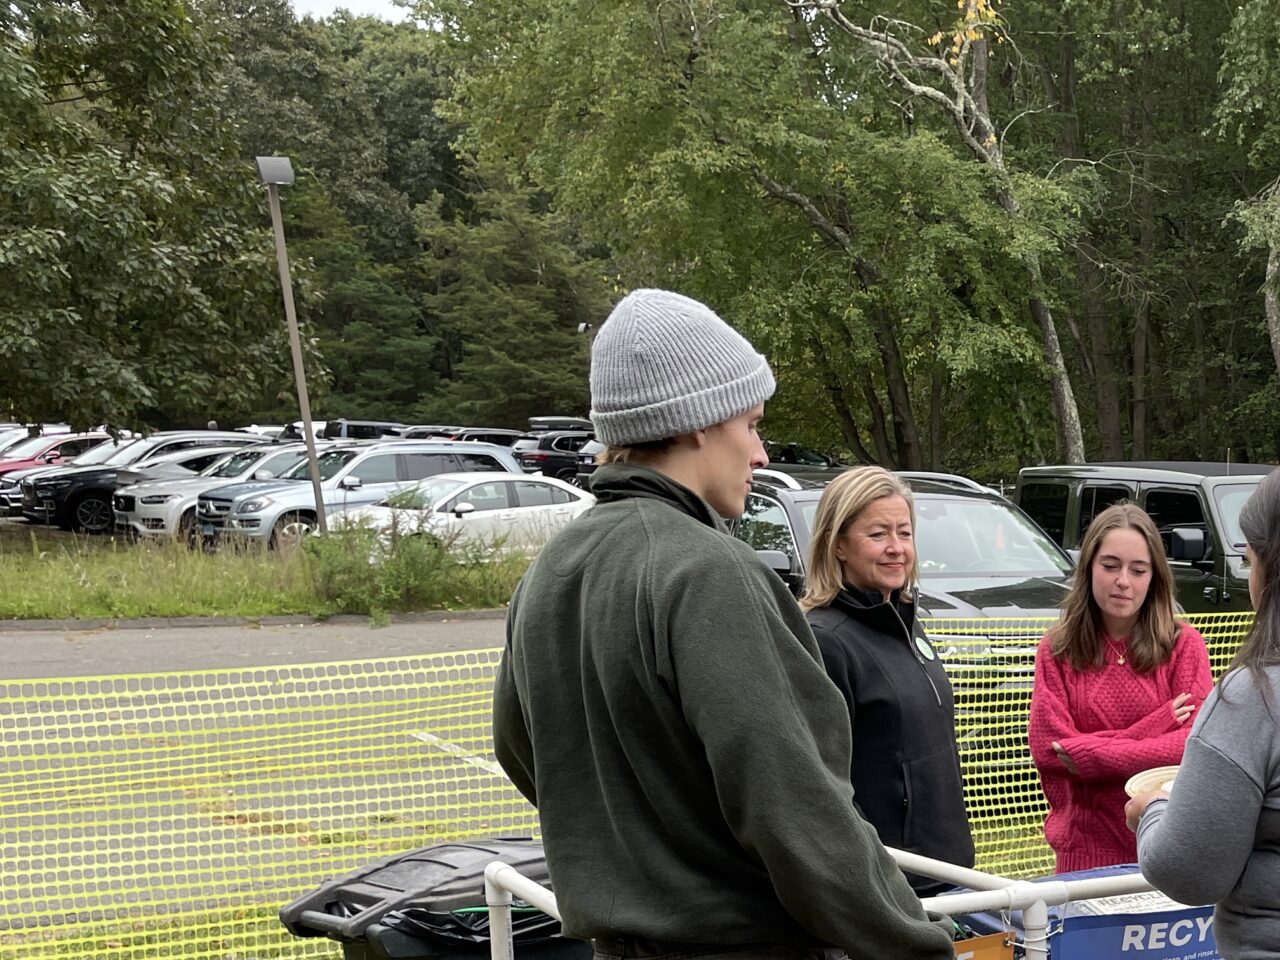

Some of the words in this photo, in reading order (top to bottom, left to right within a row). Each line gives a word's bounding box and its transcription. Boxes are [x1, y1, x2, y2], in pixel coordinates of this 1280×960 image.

[1121, 914, 1216, 952] RECY
[1183, 952, 1196, 960] and
[1197, 950, 1213, 958] rinse
